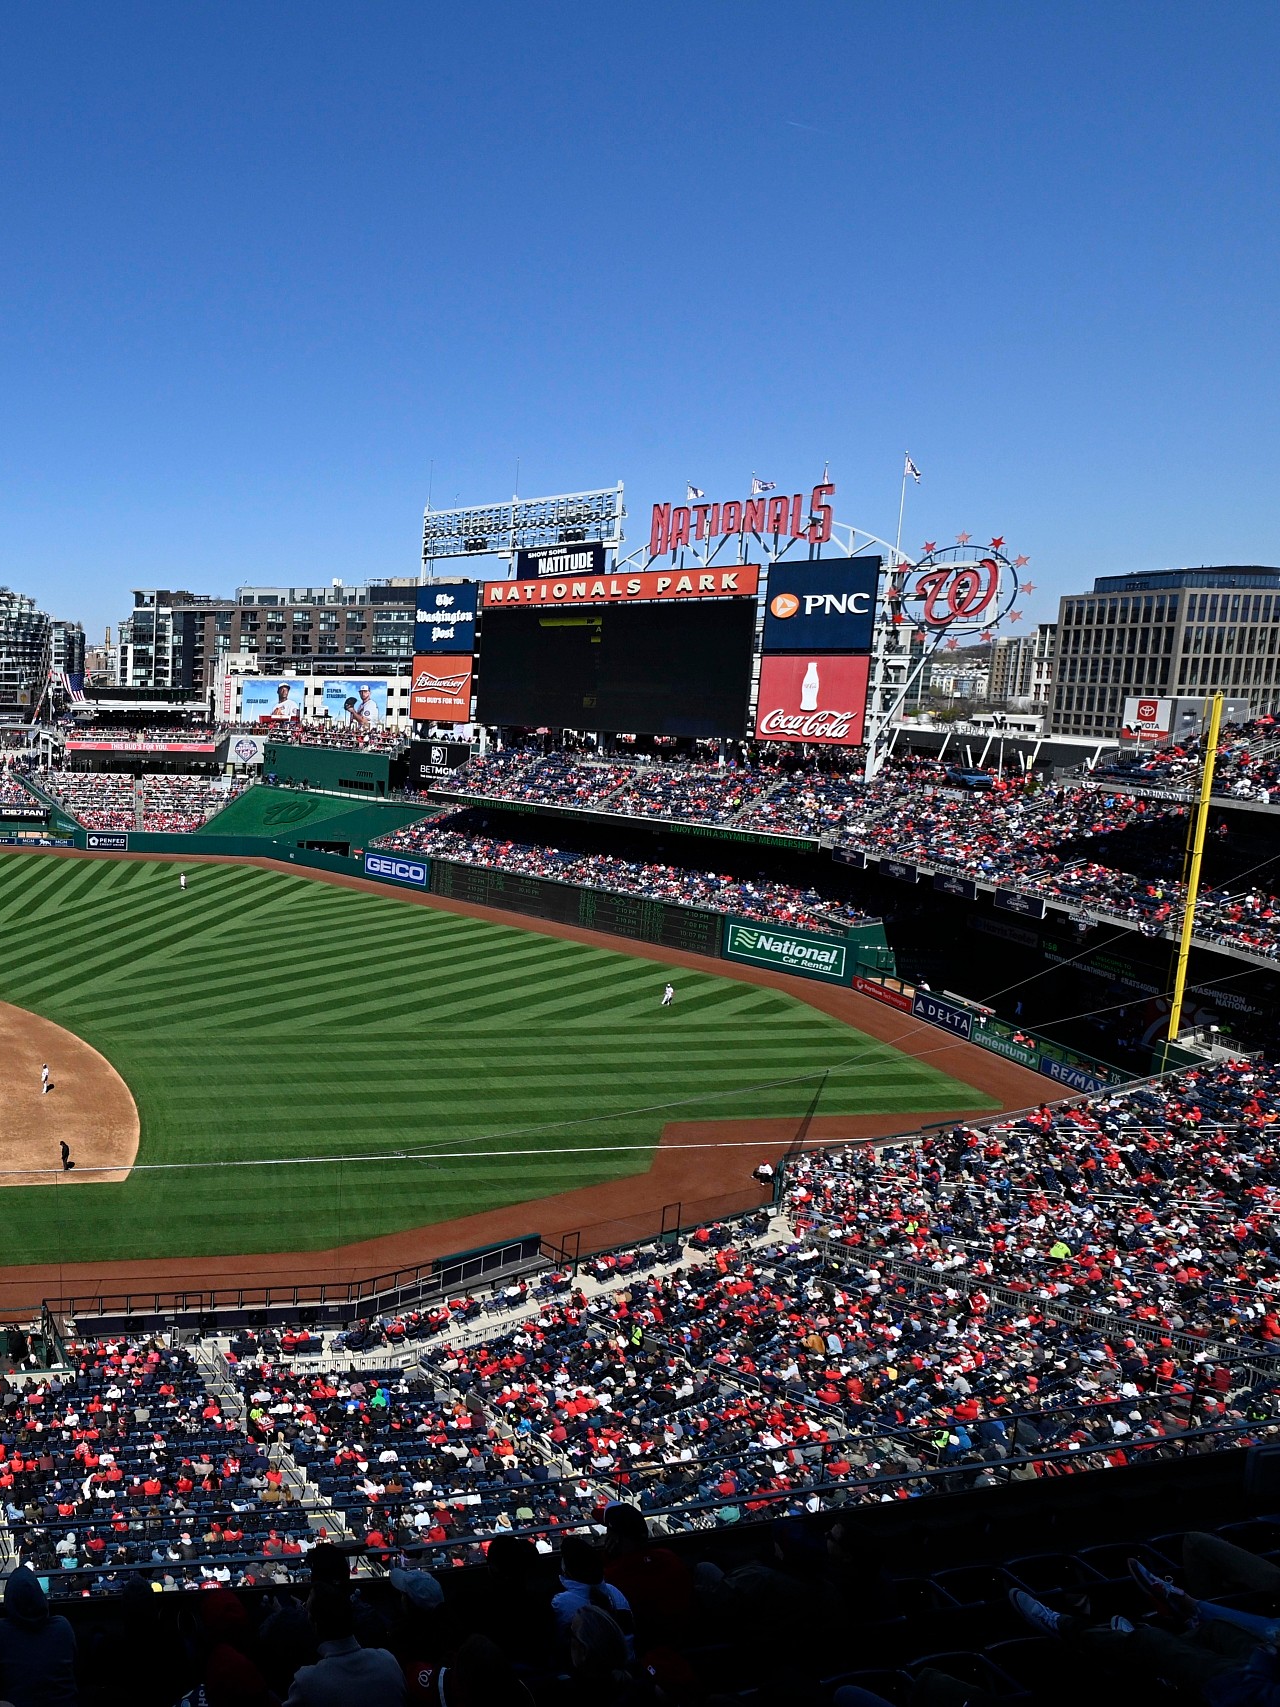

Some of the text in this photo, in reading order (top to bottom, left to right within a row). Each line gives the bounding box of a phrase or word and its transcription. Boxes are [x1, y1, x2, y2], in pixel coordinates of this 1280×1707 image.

[650, 484, 835, 555] NATIONALS
[548, 548, 567, 557] SOME
[538, 551, 594, 573] NATITUDE
[490, 573, 739, 601] NATIONALS PARK
[916, 558, 998, 625] W
[435, 594, 455, 607] The
[803, 593, 870, 615] PNC
[416, 610, 473, 625] Washington
[431, 627, 455, 642] Post
[416, 674, 464, 688] Budweiser
[760, 709, 858, 738] Coca-Cola
[420, 765, 457, 776] BETMGM
[1136, 789, 1182, 801] ROBINSON
[471, 799, 483, 807] FREE
[503, 803, 524, 812] ROLLING
[670, 825, 692, 835] ENJOY
[692, 828, 712, 837] WITH
[720, 831, 756, 844] SKYMILES
[367, 857, 424, 881] GEICO
[680, 930, 707, 941] 10:07 PM
[756, 935, 838, 964] National
[1041, 941, 1059, 951] 1:58
[782, 955, 832, 972] Car Rental
[1072, 960, 1116, 981] PHILANTHROPIES
[864, 983, 907, 1008] Raytheon Technologies
[1191, 986, 1246, 1004] WASHINGTON
[928, 1004, 969, 1032] DELTA
[974, 1032, 1027, 1062] amentum
[1110, 1072, 1121, 1085] 335
